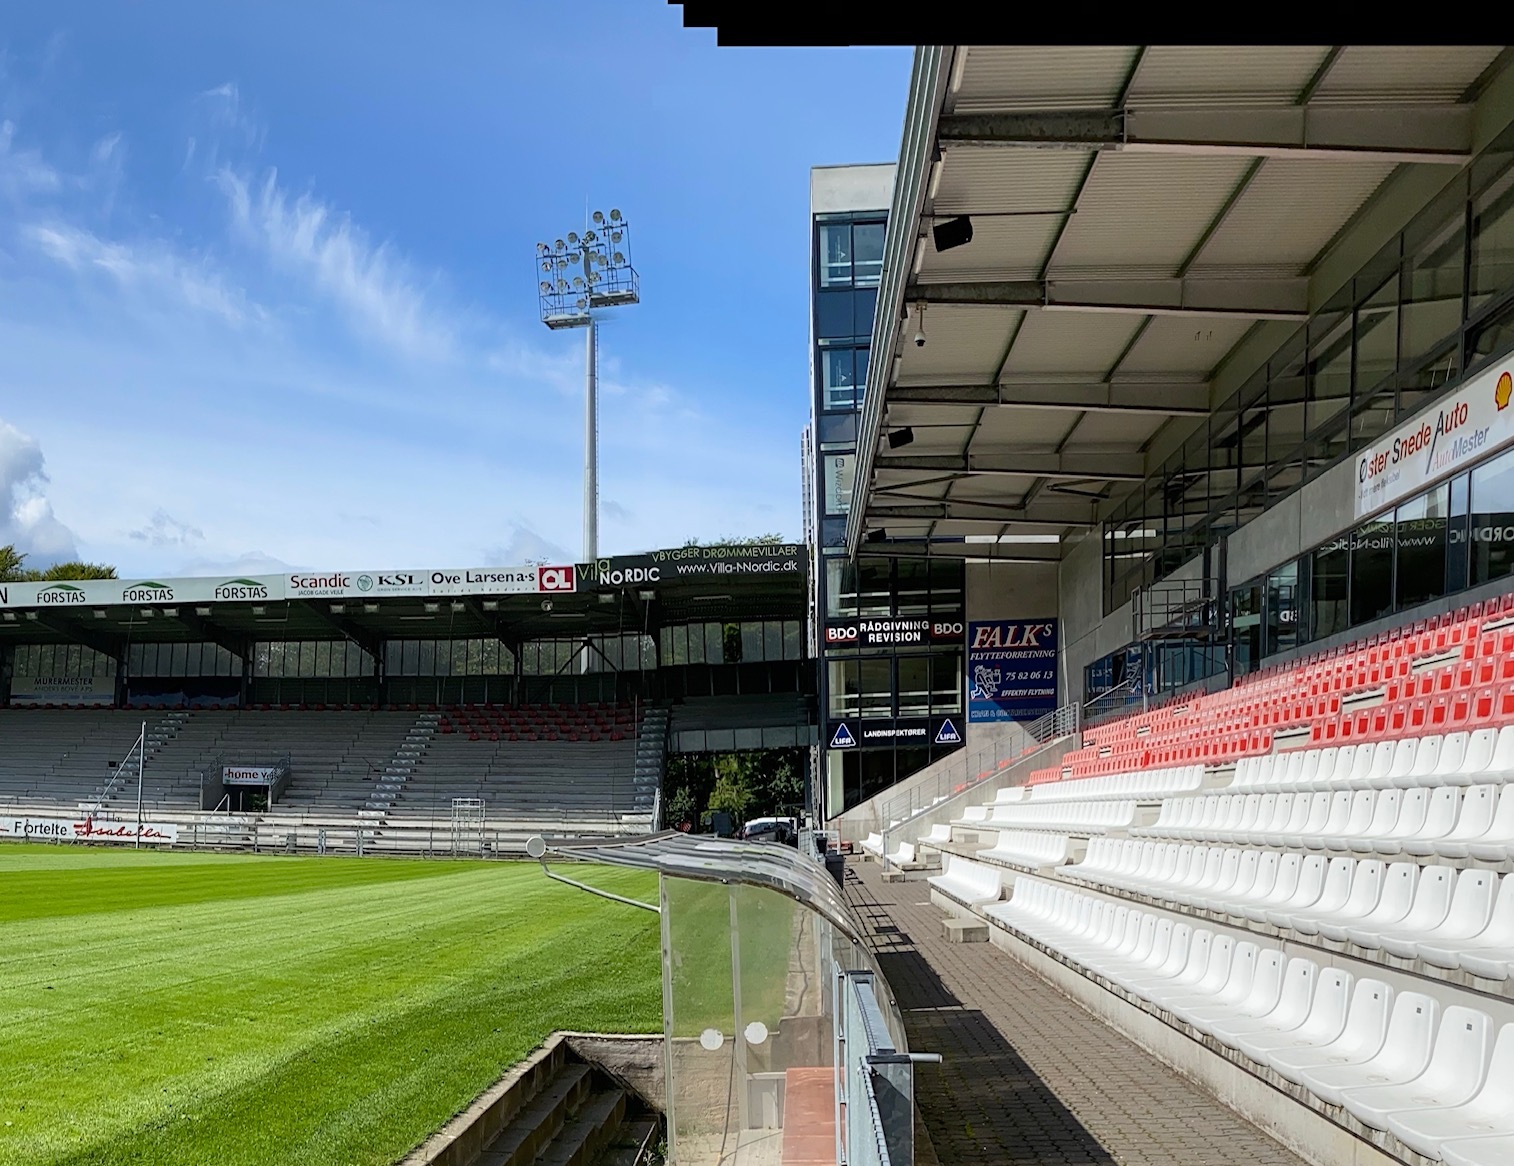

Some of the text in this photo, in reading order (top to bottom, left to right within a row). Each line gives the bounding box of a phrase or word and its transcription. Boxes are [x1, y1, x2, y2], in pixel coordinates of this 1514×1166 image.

[1359, 449, 1391, 484] Øster
[1392, 422, 1432, 464] Snede
[290, 574, 350, 589] Scandic
[378, 574, 424, 586] KSL
[431, 572, 461, 585] Ove
[465, 570, 514, 584] Larsen
[599, 567, 661, 585] NORDIC
[36, 591, 86, 604] FORSTAS
[122, 589, 174, 602] FORSTAS
[214, 587, 268, 600] FORSTAS
[859, 620, 930, 633] RÅDGIVNING
[934, 622, 963, 635] BDO
[828, 626, 858, 641] BDO
[868, 631, 922, 643] REVISION
[969, 649, 1056, 661] FLYTTEFORRETNING
[33, 677, 93, 686] MURERMESTER
[1005, 670, 1054, 681] 75 82 06 13
[1000, 688, 1028, 697] EFFEKTIV
[864, 727, 926, 738] LANDINSPEKTØRER
[940, 732, 957, 741] LIFA
[835, 736, 852, 745] LIFA
[228, 768, 259, 780] home
